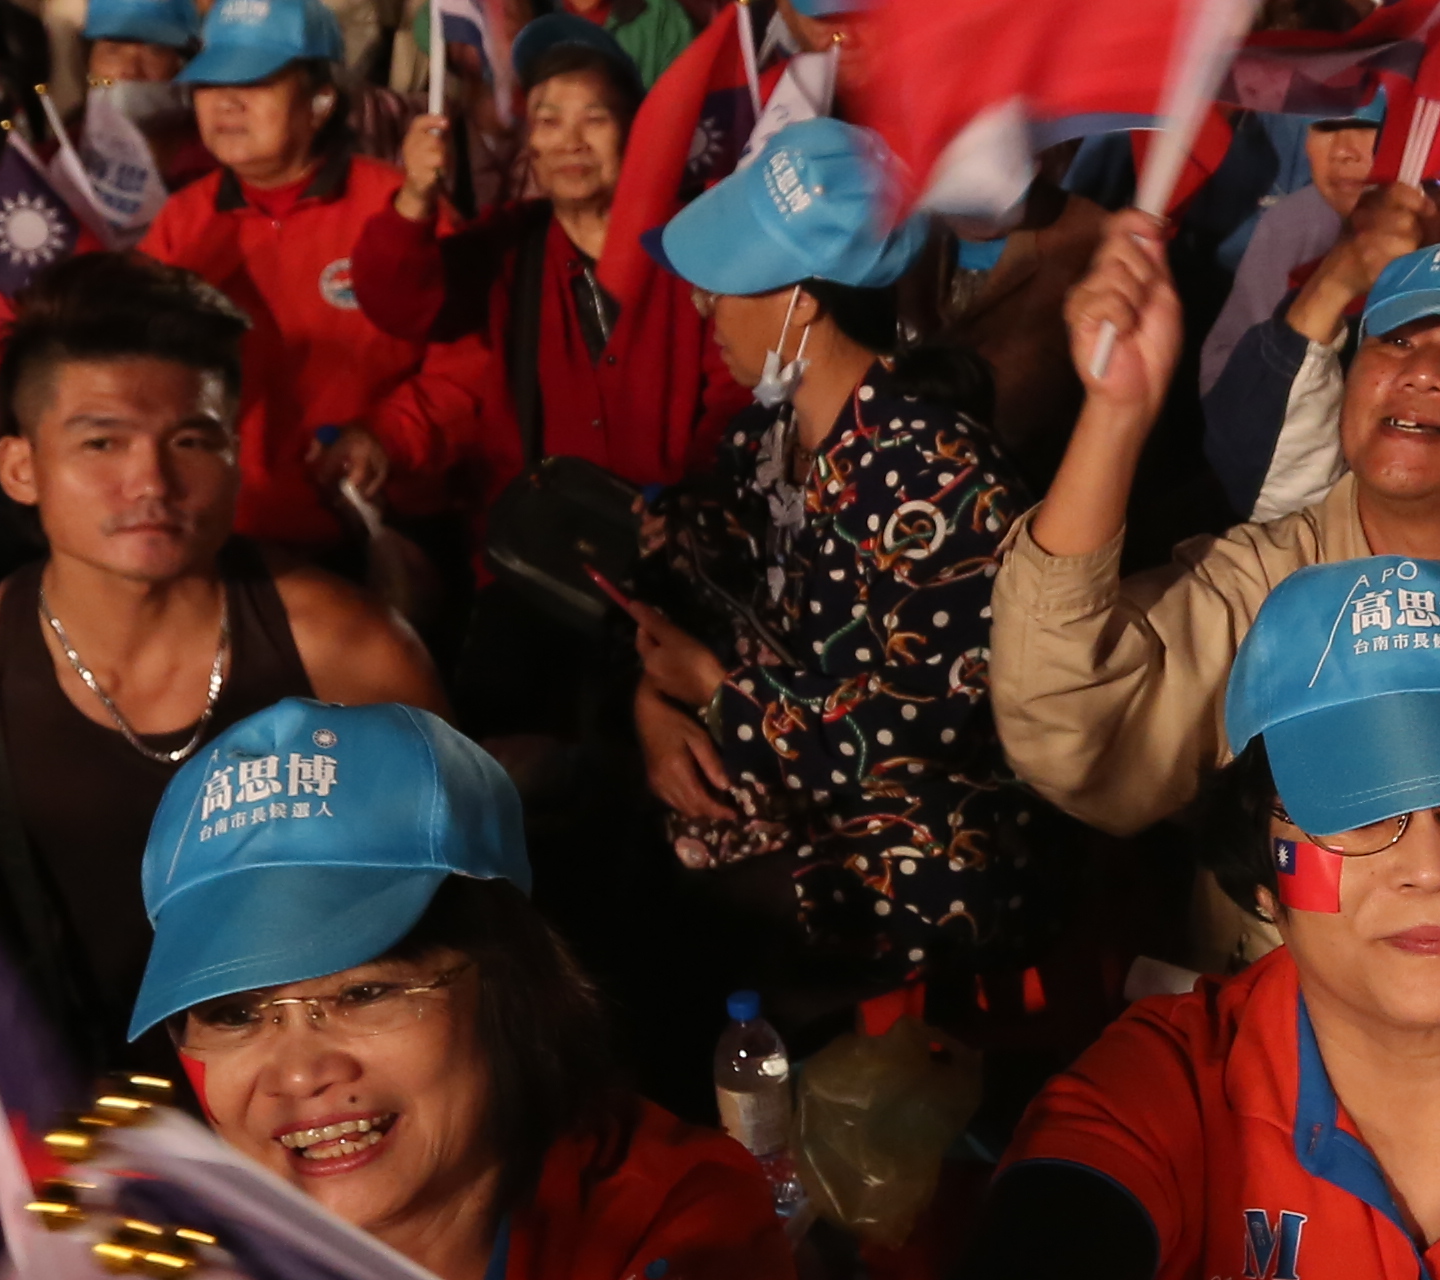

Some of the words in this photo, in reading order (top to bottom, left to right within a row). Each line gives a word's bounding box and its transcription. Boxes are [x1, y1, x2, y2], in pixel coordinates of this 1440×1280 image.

[200, 752, 339, 821] 高思博
[199, 801, 334, 842] 台南市長候選人
